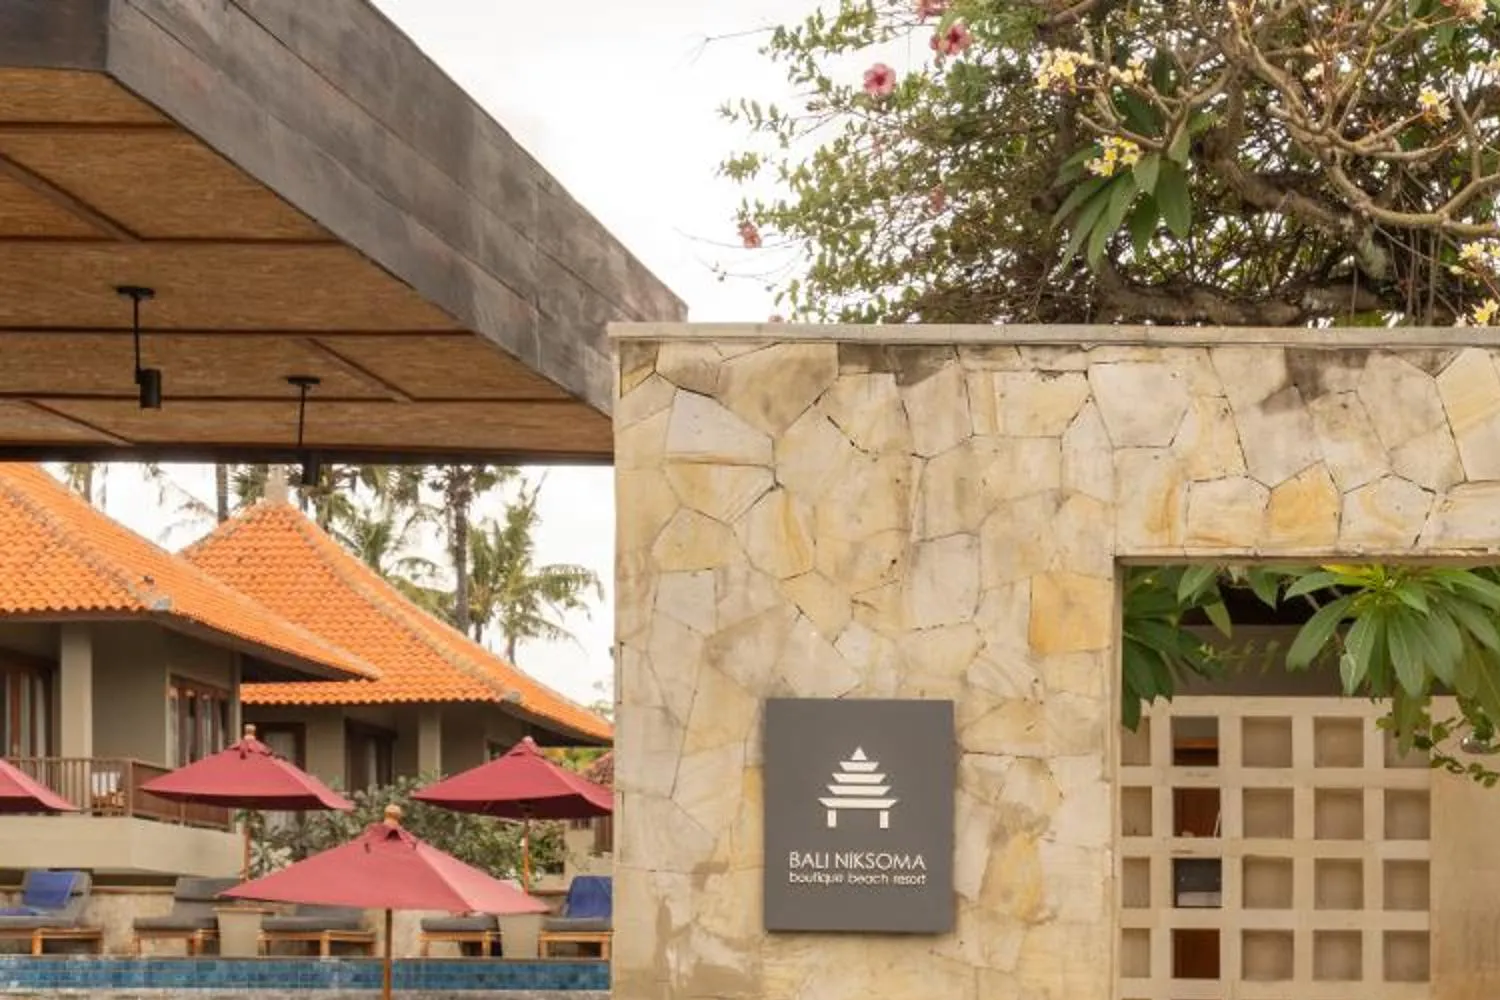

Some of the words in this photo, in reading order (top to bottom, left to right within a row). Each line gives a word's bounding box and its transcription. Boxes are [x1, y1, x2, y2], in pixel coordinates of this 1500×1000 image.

[789, 852, 829, 869] BALI
[835, 853, 926, 870] NIKSOMA
[789, 872, 843, 885] boutique
[848, 872, 889, 885] beach
[893, 874, 926, 885] resort
